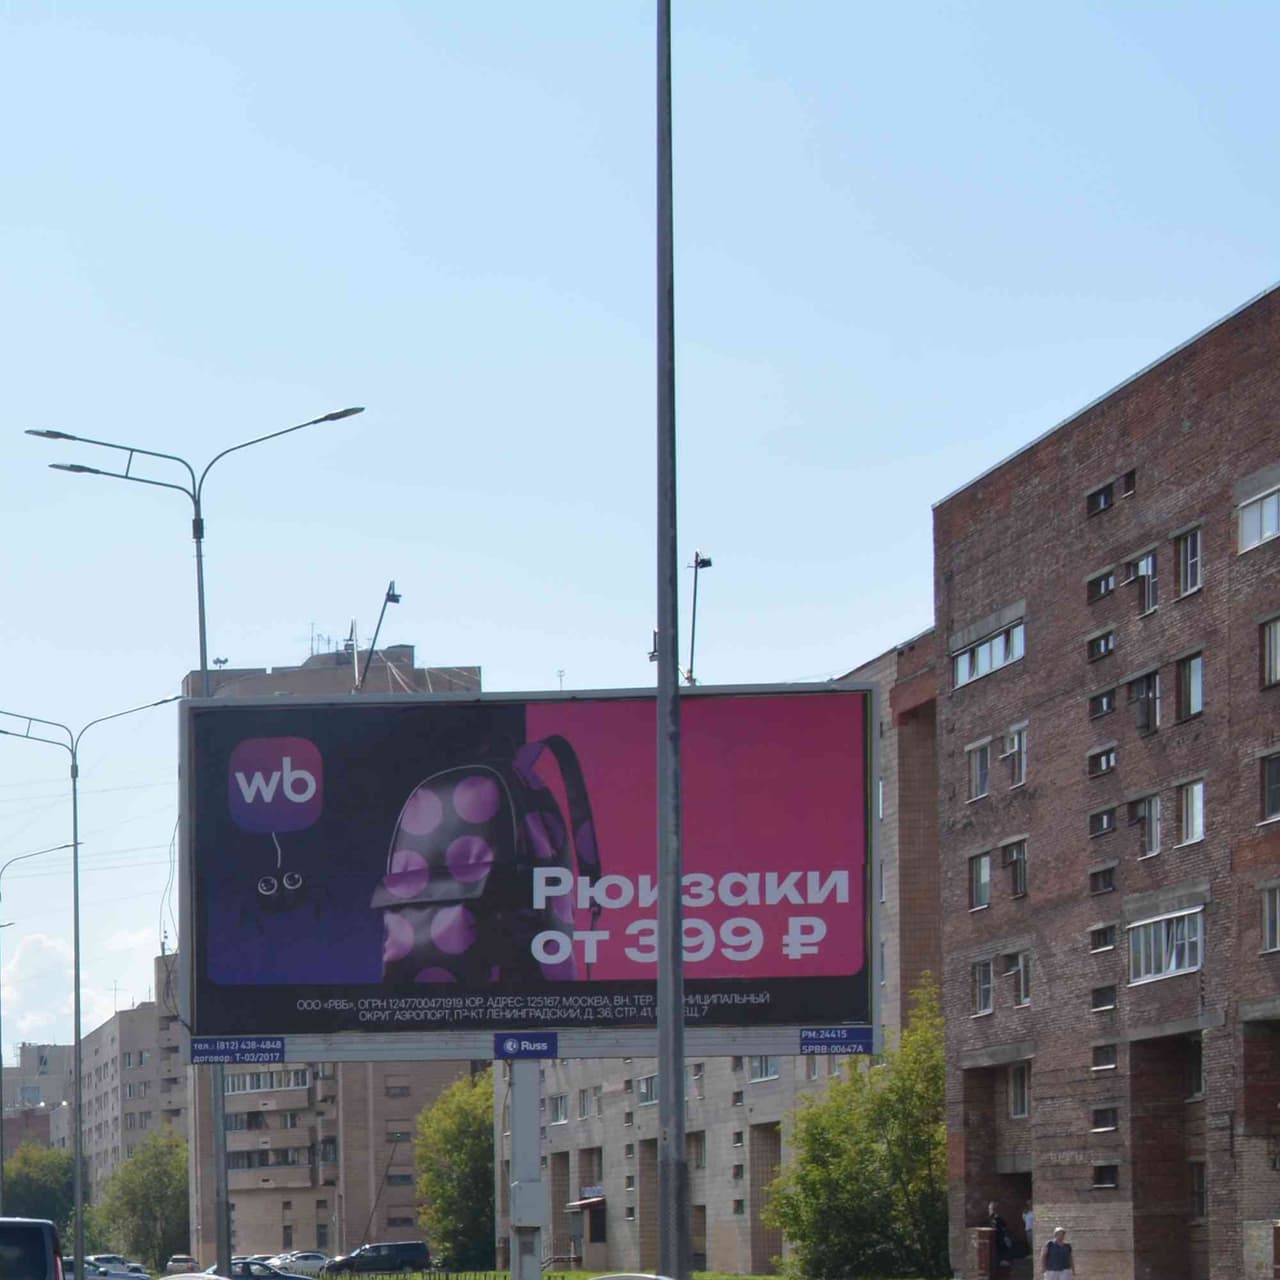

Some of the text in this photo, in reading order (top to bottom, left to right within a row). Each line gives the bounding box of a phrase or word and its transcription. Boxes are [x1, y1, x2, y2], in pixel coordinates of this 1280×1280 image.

[235, 756, 317, 803] wb
[531, 929, 610, 964] от
[624, 917, 765, 963] 399
[297, 999, 321, 1010] ООО
[358, 998, 386, 1010] ОГРН
[359, 1010, 392, 1021] ОКРУГ
[216, 1040, 239, 1051] (812)
[521, 1040, 548, 1051] Russ
